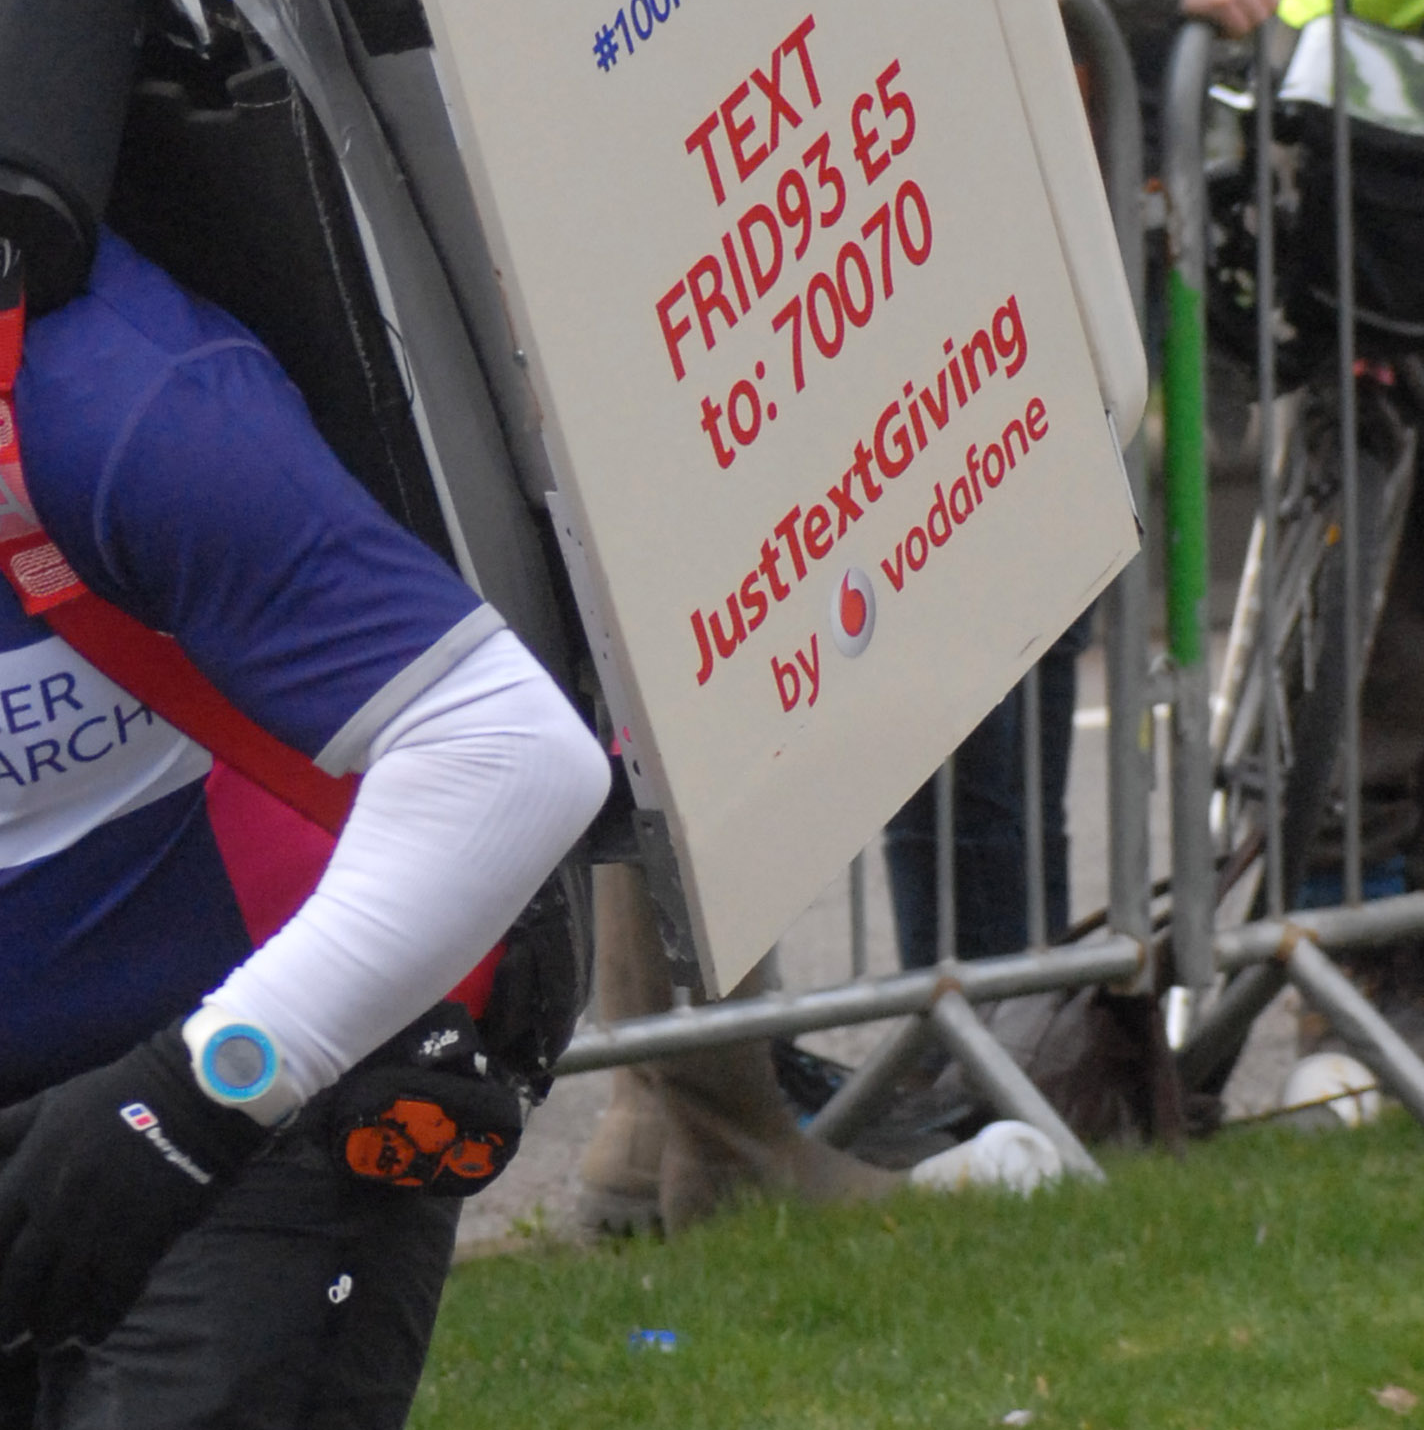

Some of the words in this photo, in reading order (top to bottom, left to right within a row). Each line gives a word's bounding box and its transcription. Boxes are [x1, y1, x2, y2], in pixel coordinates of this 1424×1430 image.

[654, 130, 848, 382] FRID93
[850, 57, 917, 186] £5
[684, 13, 823, 207] TEXT
[699, 358, 779, 470] to:
[770, 178, 934, 394] 70070
[689, 292, 1029, 687] JustTextGiving
[770, 632, 821, 713] by
[879, 395, 1050, 594] vodafone
